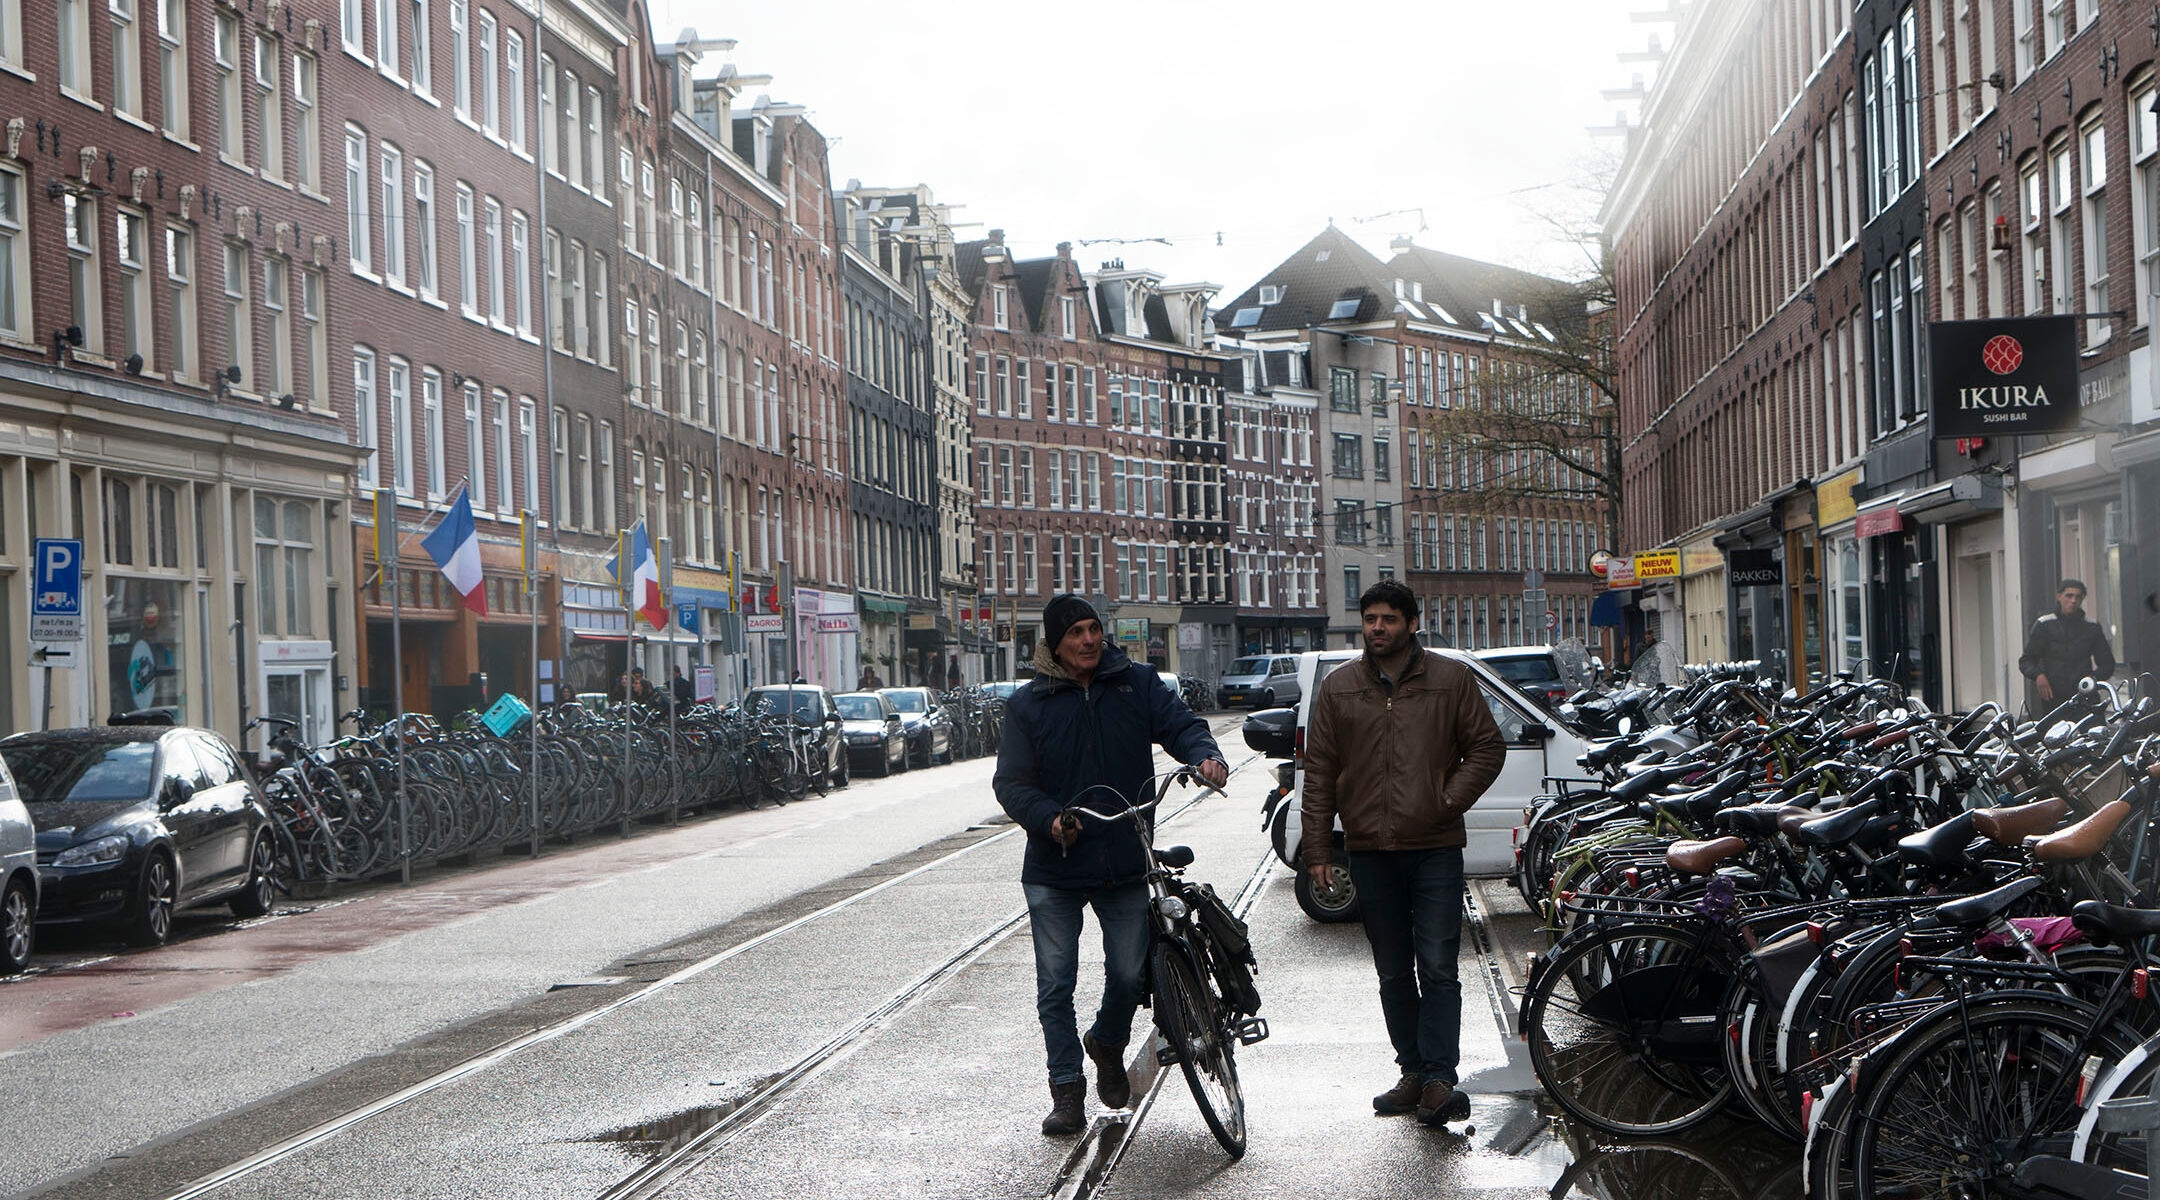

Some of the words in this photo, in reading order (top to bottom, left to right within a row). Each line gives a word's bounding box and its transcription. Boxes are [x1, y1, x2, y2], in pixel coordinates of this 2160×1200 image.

[1960, 384, 2052, 410] IKURA
[1983, 413, 2009, 423] SUSHI
[2010, 412, 2027, 421] BAR
[46, 546, 72, 583] P
[1641, 559, 1672, 568] NIEUW
[1641, 567, 1675, 577] ALBINA
[1732, 569, 1779, 582] BAKKEN
[683, 611, 692, 625] P
[749, 619, 781, 628] ZAGROS
[819, 619, 848, 630] Nails
